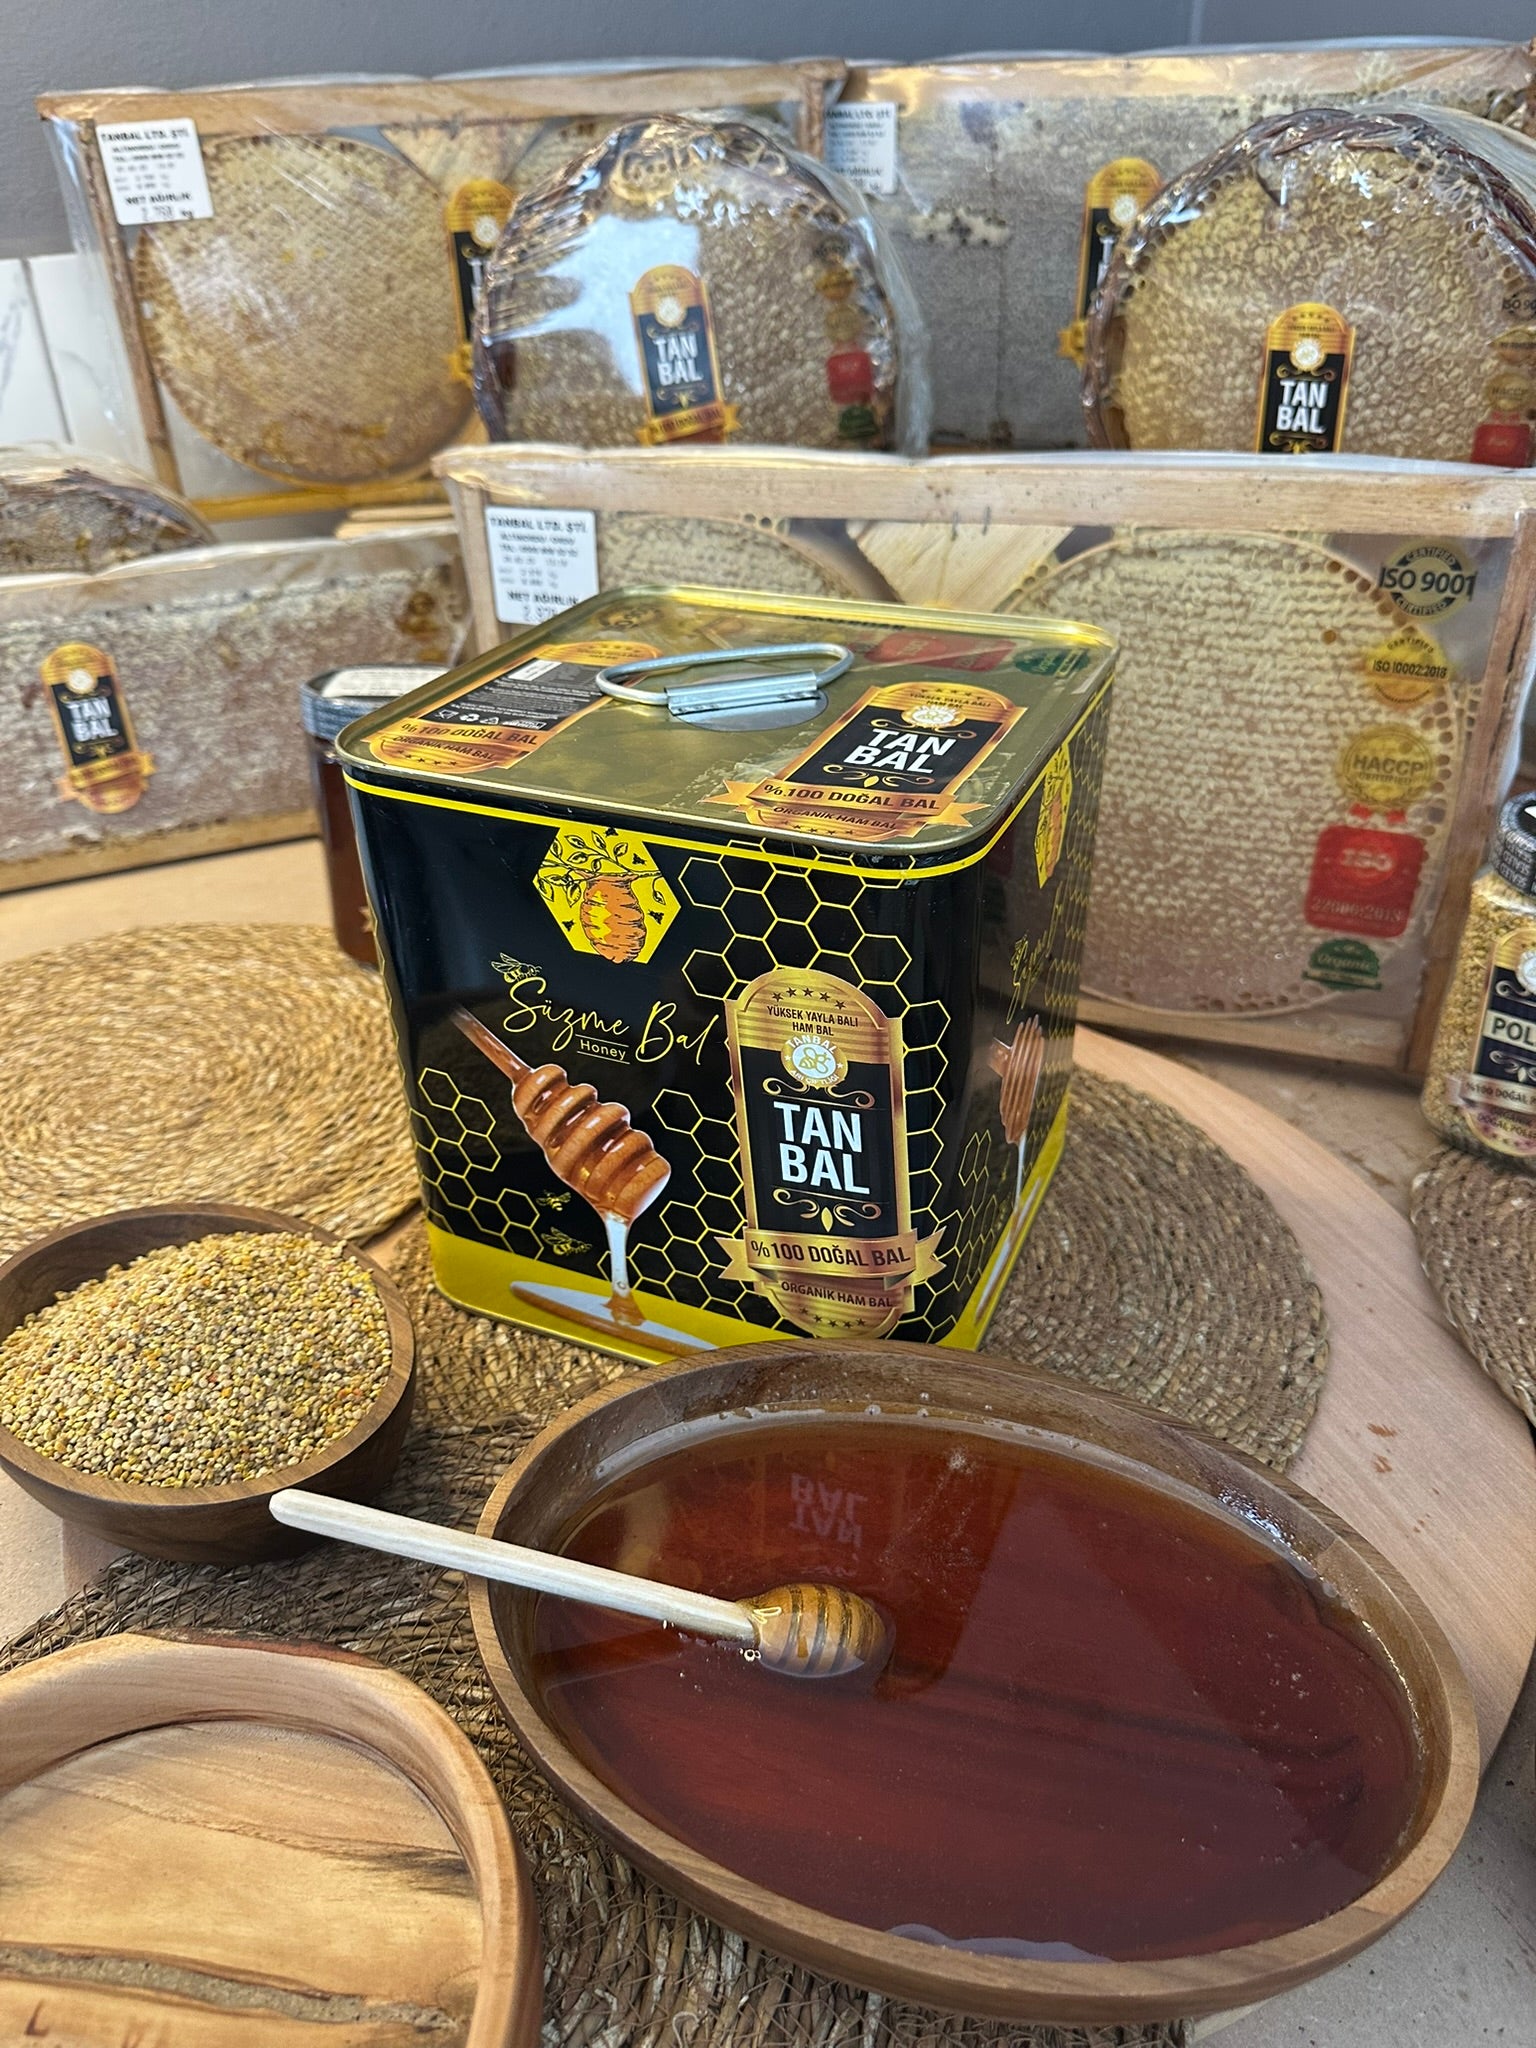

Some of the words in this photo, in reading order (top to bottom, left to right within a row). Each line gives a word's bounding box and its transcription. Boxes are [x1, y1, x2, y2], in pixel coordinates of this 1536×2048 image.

[653, 331, 698, 362] TAN
[657, 358, 703, 387] BAL
[1279, 379, 1329, 409] TAN
[1276, 403, 1327, 434] BAL
[1379, 566, 1416, 590] ISO
[1420, 570, 1478, 602] 9001
[1373, 660, 1391, 673] ISO
[66, 697, 112, 724] TAN
[451, 728, 503, 741] DOĞAL
[507, 733, 538, 745] BAL
[868, 728, 957, 756] TAN
[443, 744, 470, 755] HAM
[471, 750, 496, 760] BAL
[843, 744, 934, 774] BAL
[1353, 754, 1424, 777] HACCP
[827, 792, 894, 807] DOĞAL
[900, 798, 941, 810] BAL
[773, 806, 835, 819] ORGANİK
[836, 814, 868, 825] HAM
[868, 820, 898, 830] BAL
[503, 976, 631, 1052] Süzme
[635, 1000, 720, 1066] Bal
[766, 1005, 804, 1021] YÜKSEK
[805, 1011, 835, 1024] YAYLA
[837, 1016, 859, 1028] BALI
[792, 1022, 814, 1034] HAM
[816, 1025, 835, 1036] BAL
[579, 1038, 627, 1061] Honey
[785, 1034, 837, 1054] TANBAL
[773, 1101, 863, 1154] TAN
[778, 1142, 870, 1195] BAL
[808, 1244, 870, 1267] DOĞAL
[872, 1246, 912, 1266] BAL
[781, 1281, 836, 1301] ORGANİK
[837, 1291, 866, 1307] HAM
[868, 1297, 894, 1308] BAL
